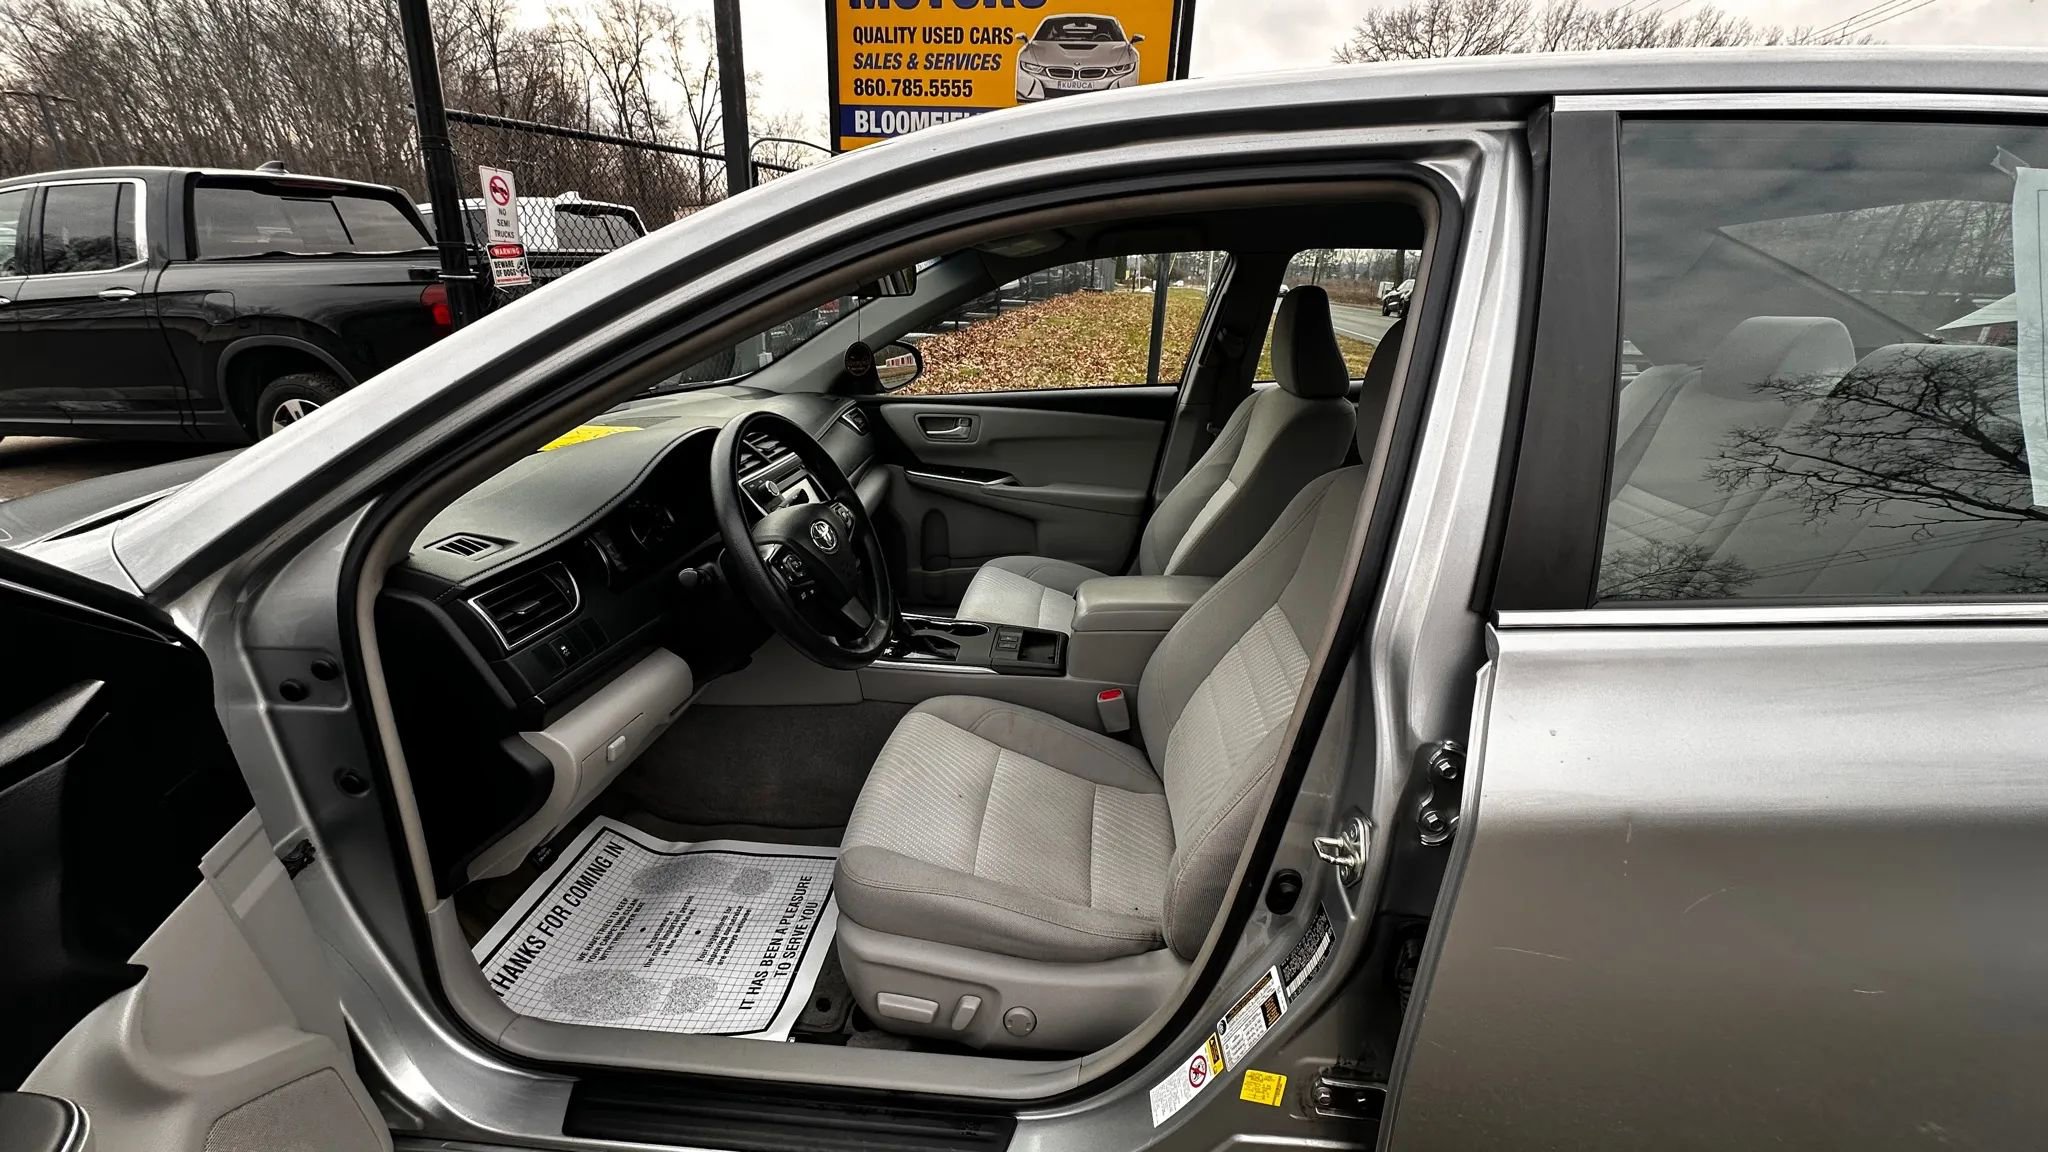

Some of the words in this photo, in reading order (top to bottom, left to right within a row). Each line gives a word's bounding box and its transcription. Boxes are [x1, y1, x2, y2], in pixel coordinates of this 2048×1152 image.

[853, 27, 916, 45] QUALITY
[923, 27, 963, 44] USED
[970, 27, 1014, 45] CARS
[853, 53, 902, 70] SALES
[907, 54, 919, 70] &
[923, 53, 1002, 71] SERVICES
[853, 79, 973, 97] 860.785.5555
[498, 208, 506, 216] NO
[494, 230, 514, 239] TRUCKS
[493, 247, 520, 256] WARNING
[494, 260, 514, 269] BEWARE
[536, 905, 572, 937] FOR
[562, 856, 613, 907] COMING
[603, 841, 625, 858] IN
[779, 875, 812, 925] PLEASURE
[577, 952, 588, 961] WE
[584, 936, 600, 951] HAVE
[596, 919, 613, 935] TRIED
[616, 898, 628, 911] KEEP
[775, 927, 788, 935] A
[774, 962, 791, 978] TO
[783, 924, 808, 959] SERVE
[799, 902, 818, 922] YOU
[586, 947, 602, 963] YOUR
[760, 938, 783, 967] BEEN
[643, 957, 655, 967] the
[746, 971, 768, 995] HAS
[739, 999, 755, 1010] IT
